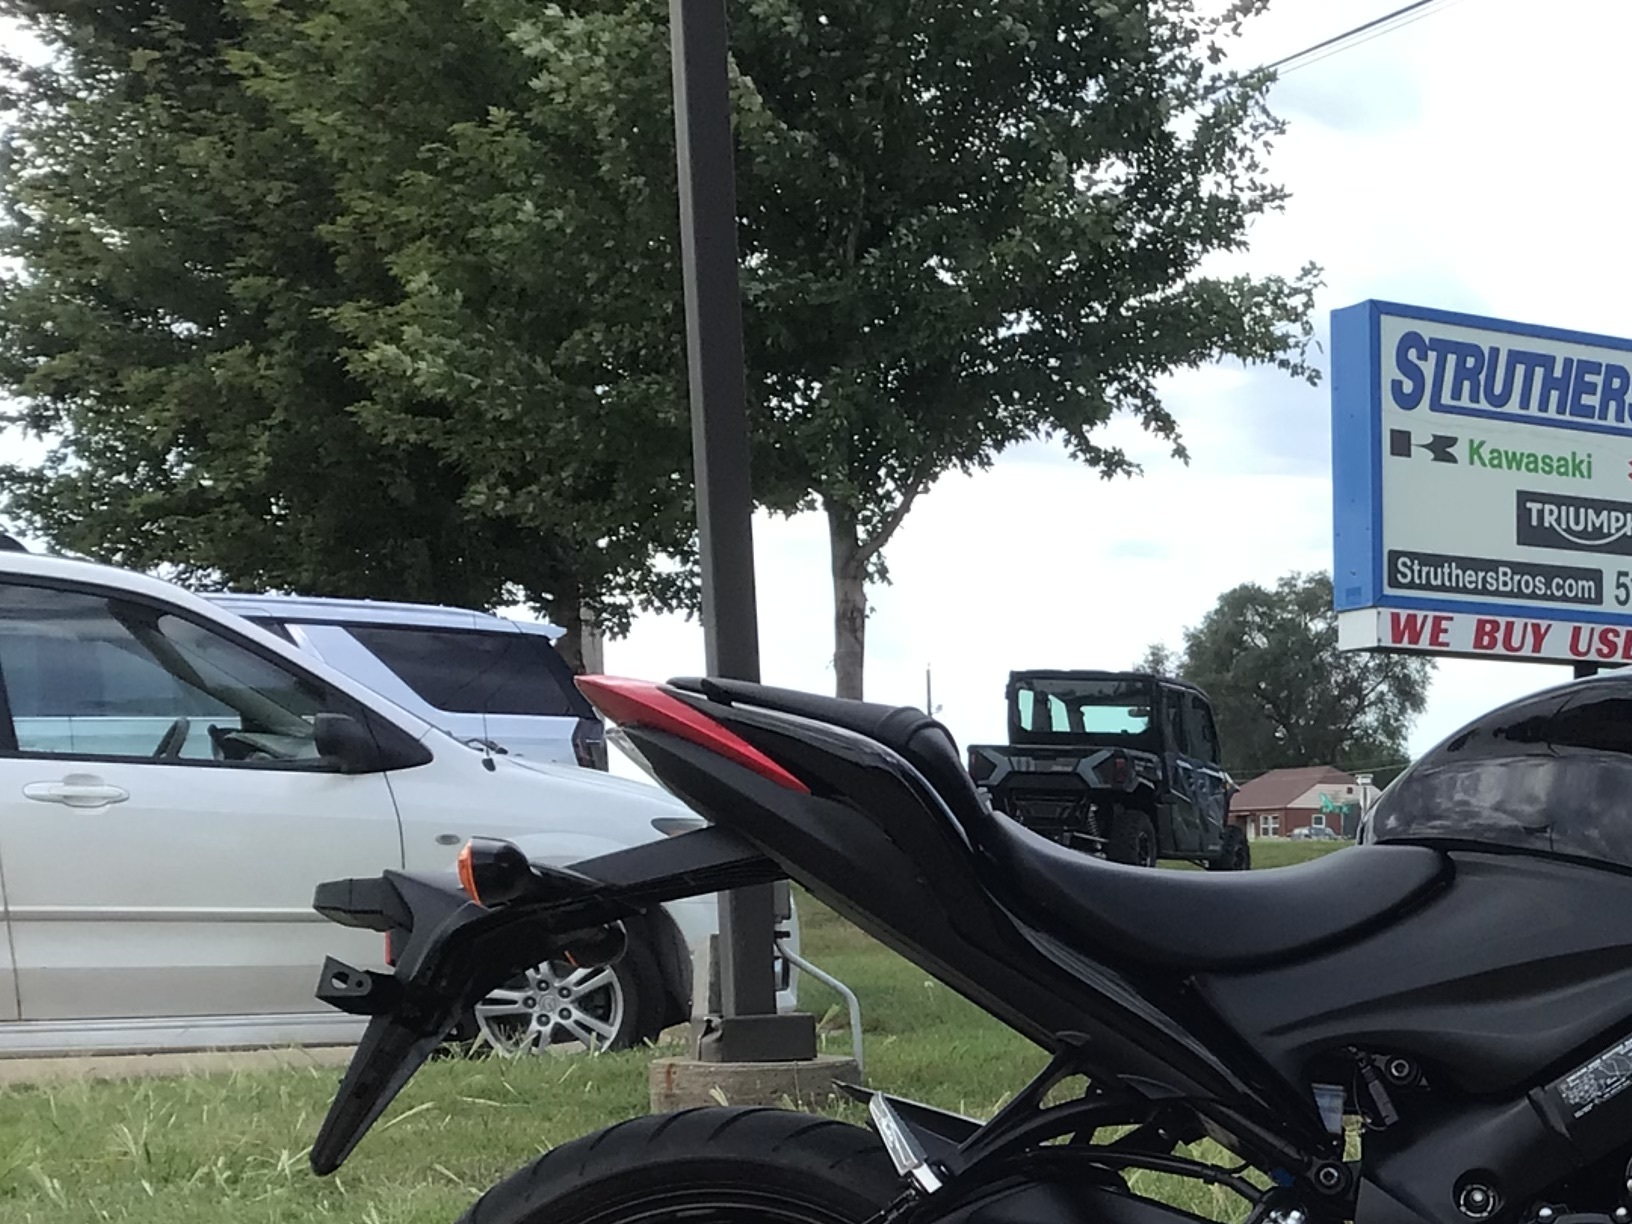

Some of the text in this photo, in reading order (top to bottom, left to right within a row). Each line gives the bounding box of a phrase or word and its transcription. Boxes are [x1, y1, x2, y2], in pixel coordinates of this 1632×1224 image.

[1468, 438, 1593, 479] Kawasaki
[1396, 556, 1596, 600] StruthersBros.com
[1389, 611, 1454, 647] WE
[1472, 618, 1553, 654] BUY
